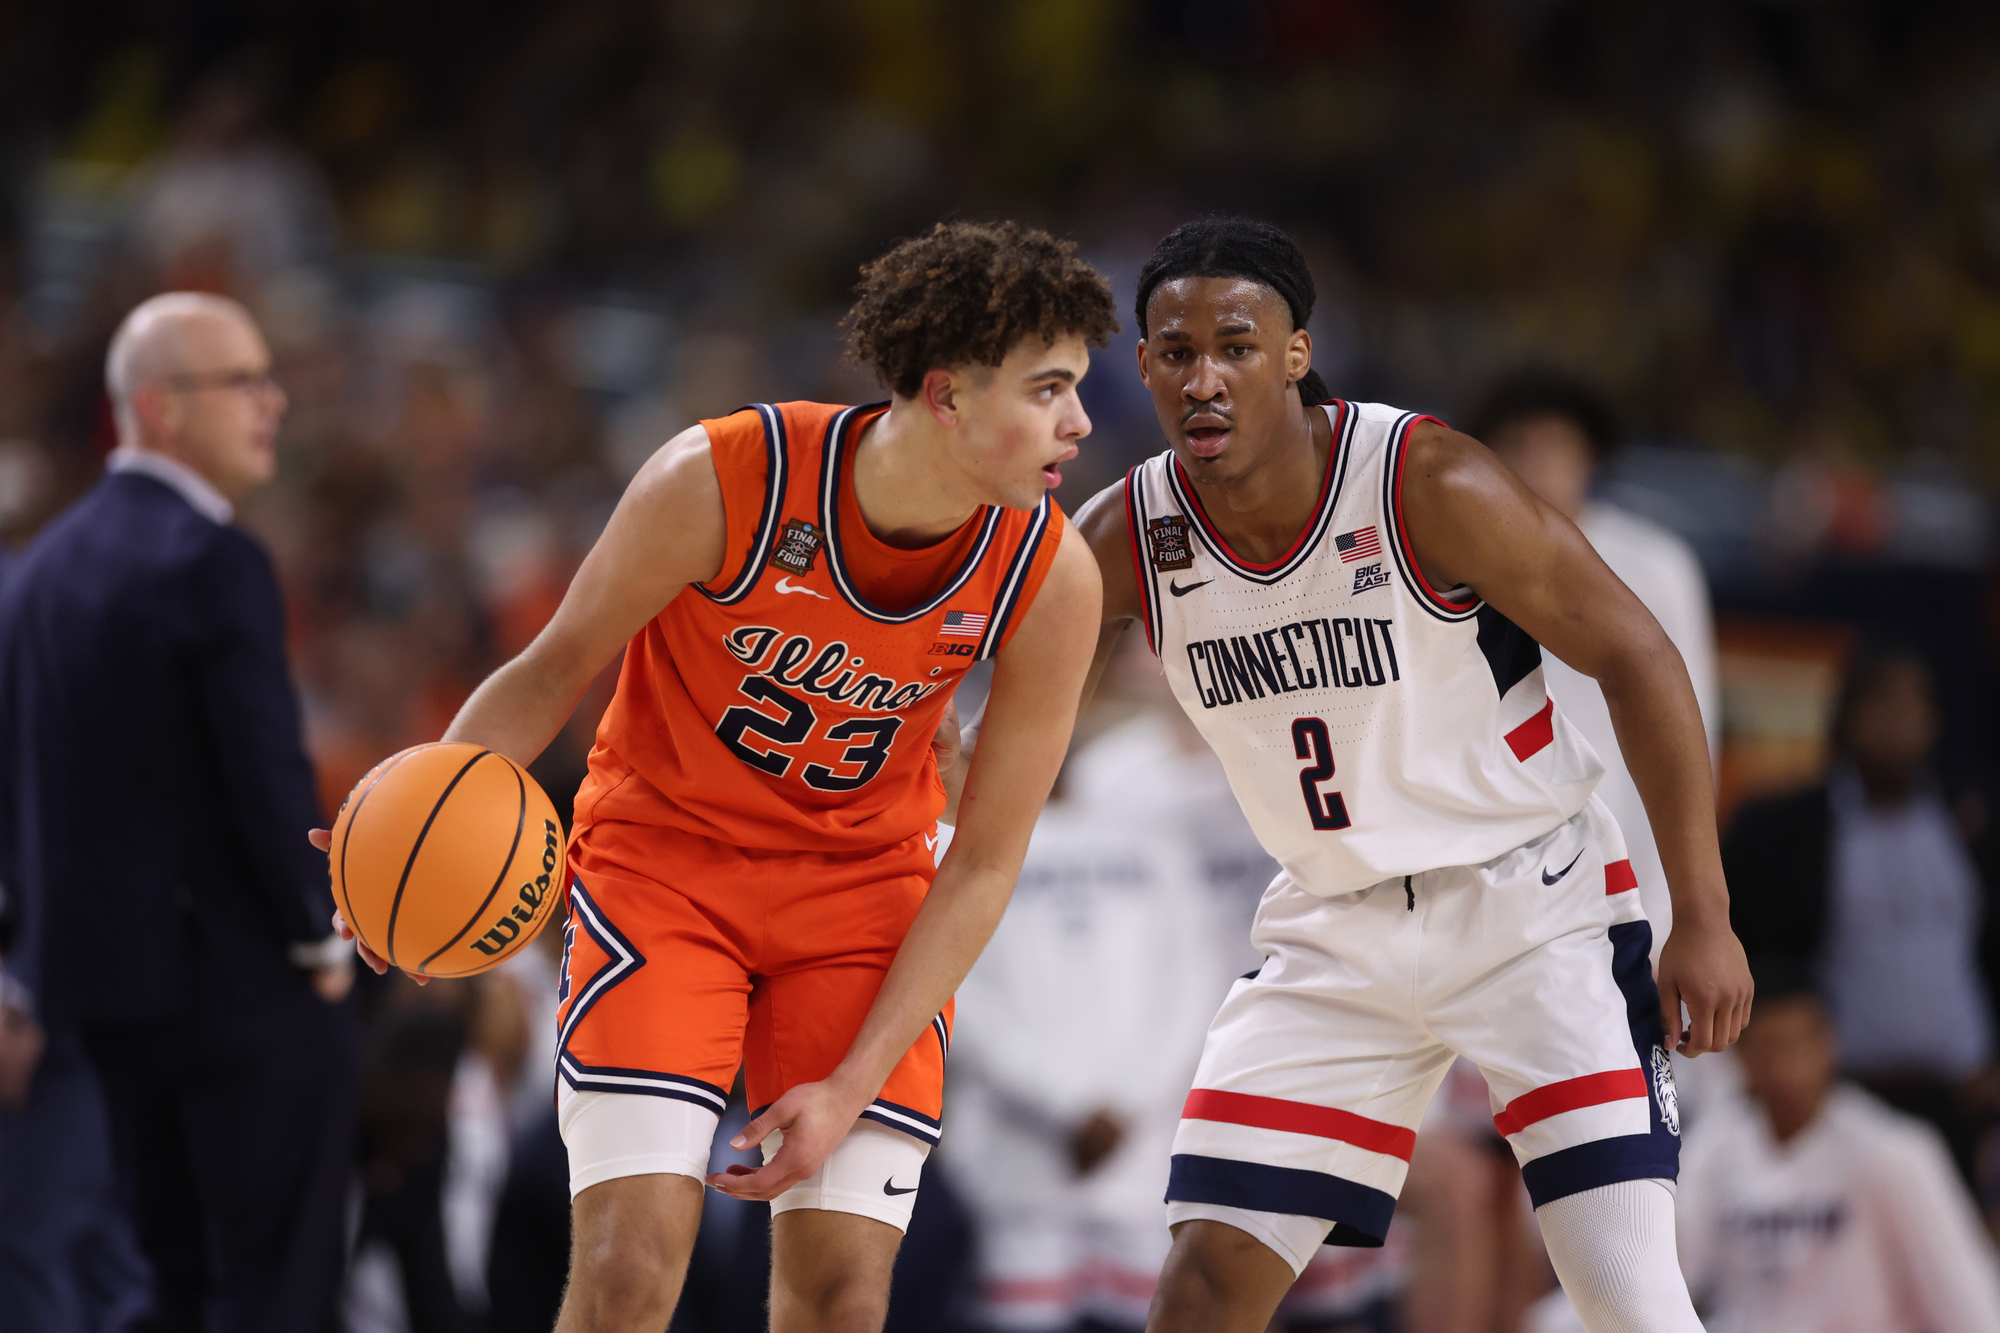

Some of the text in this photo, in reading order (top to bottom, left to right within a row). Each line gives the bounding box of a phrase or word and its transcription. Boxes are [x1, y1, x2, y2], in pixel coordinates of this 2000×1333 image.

[787, 529, 818, 548] FINAL
[1153, 526, 1183, 540] FINAL
[777, 549, 808, 567] FOUR
[1159, 549, 1187, 562] FOUR
[1355, 562, 1382, 579] BIG
[1353, 571, 1391, 590] EAST
[927, 642, 975, 656] BIG
[1186, 617, 1400, 709] CONNECTICUT
[714, 674, 905, 792] 23
[1291, 716, 1351, 831] 2
[468, 818, 558, 956] Wilson
